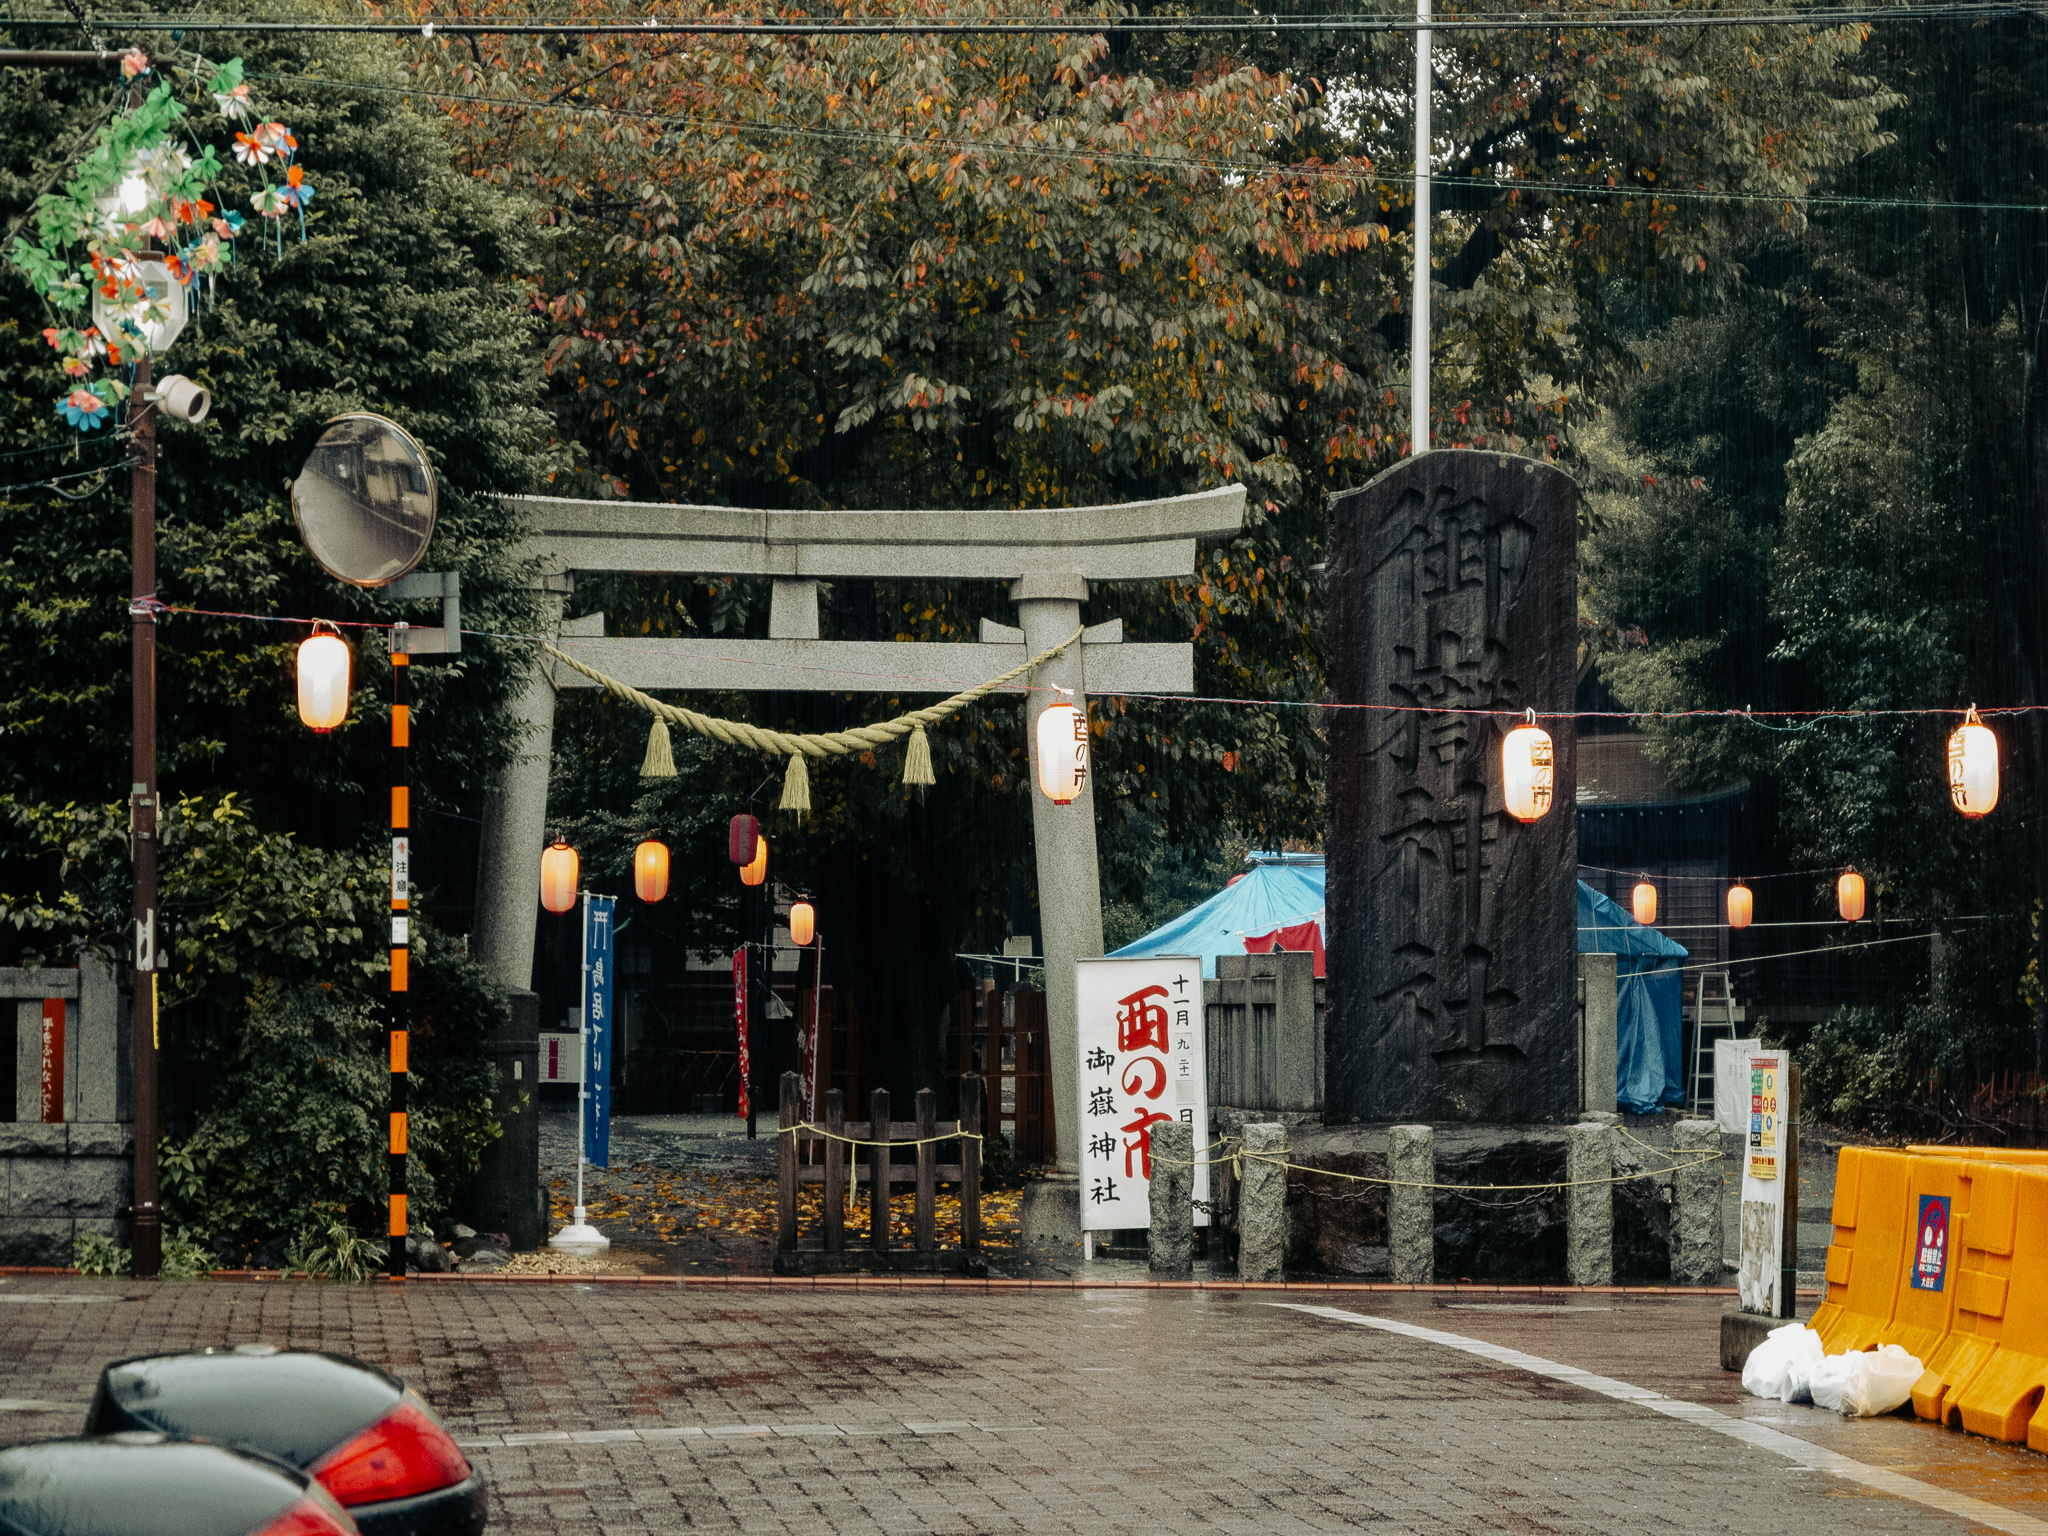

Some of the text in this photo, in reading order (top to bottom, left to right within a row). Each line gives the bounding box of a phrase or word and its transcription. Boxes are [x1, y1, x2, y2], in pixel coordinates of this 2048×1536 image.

[1364, 485, 1537, 1068] 御嶽神社
[1530, 740, 1552, 807] 酉の市
[396, 861, 407, 892] 注意
[1086, 1047, 1121, 1204] 御嶽神社
[1116, 985, 1173, 1180] 酉の市
